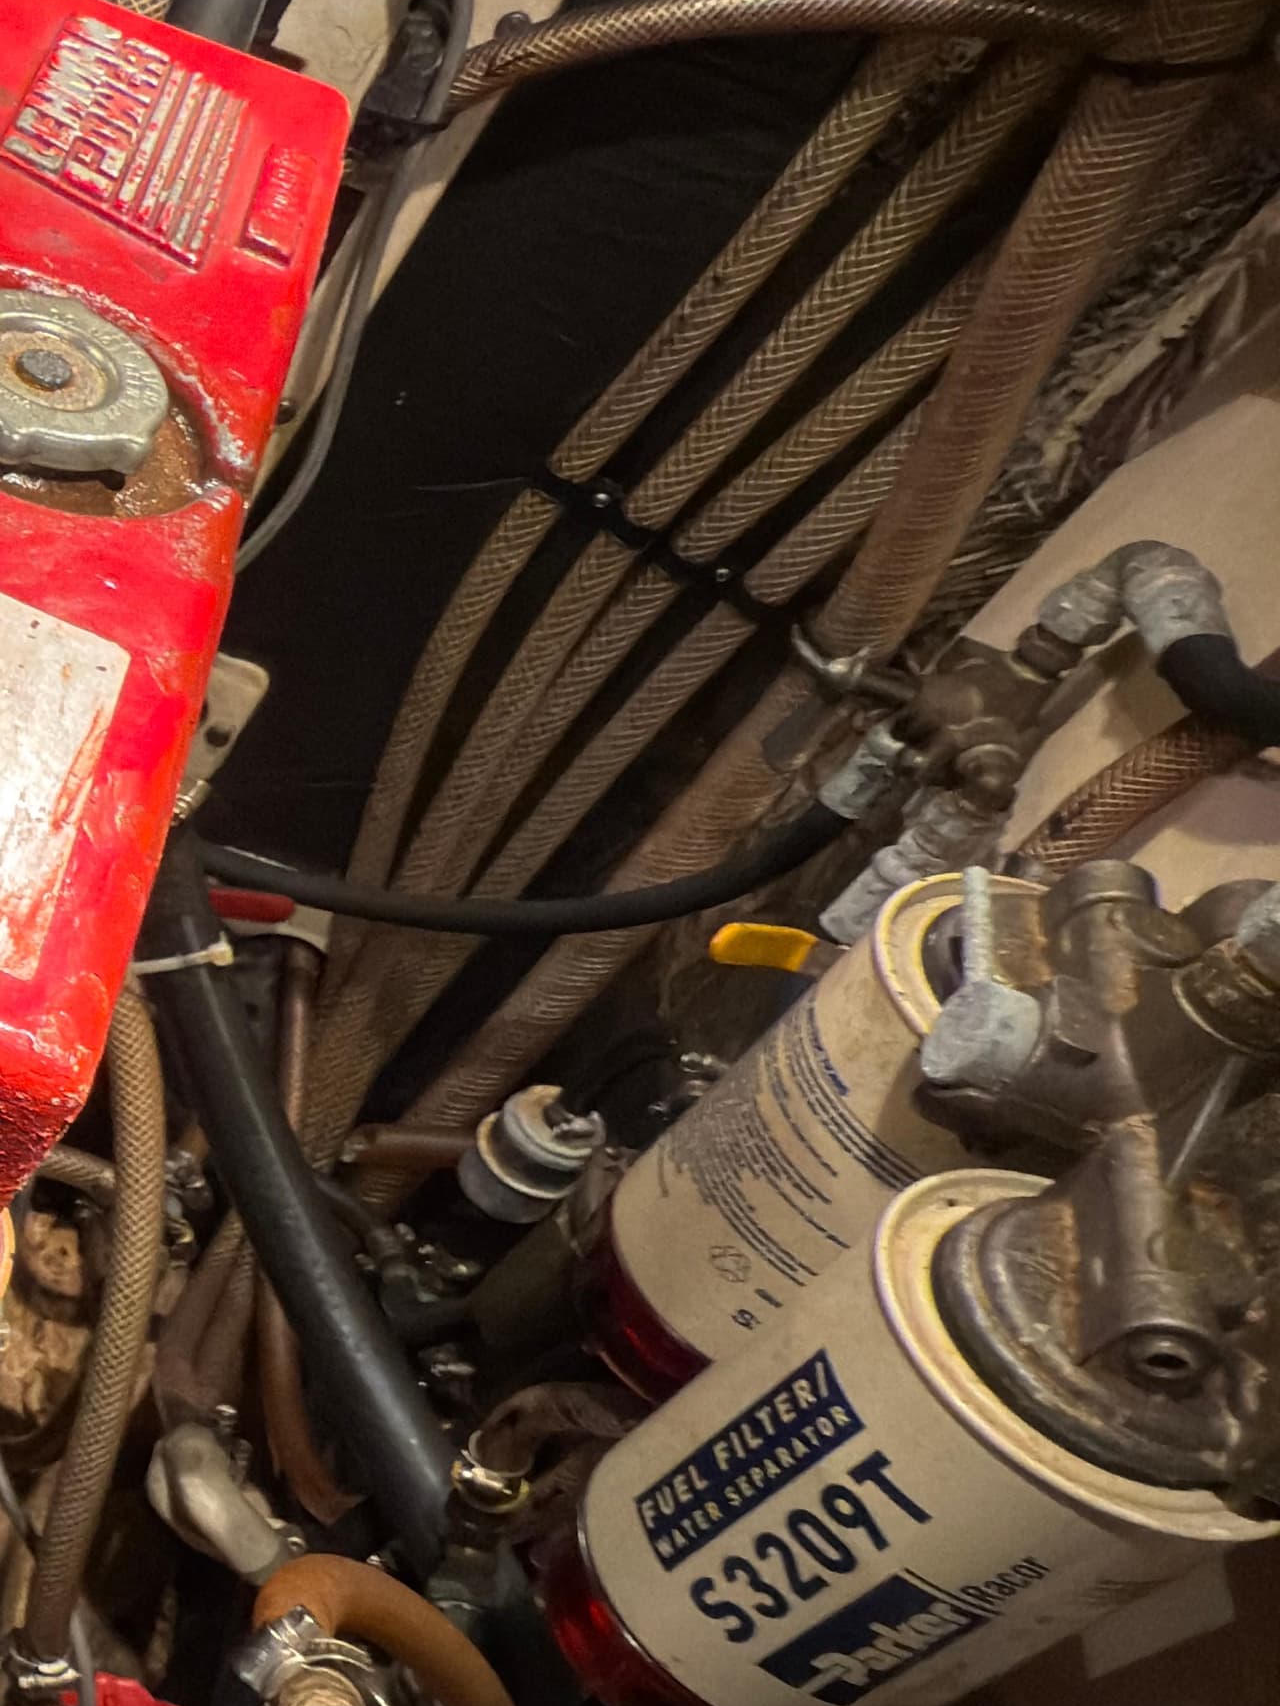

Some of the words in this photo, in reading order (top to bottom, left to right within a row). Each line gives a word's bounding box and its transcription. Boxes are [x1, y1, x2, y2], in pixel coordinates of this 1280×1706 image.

[0, 15, 124, 175] LEHMAN
[61, 37, 171, 199] POWER
[640, 1461, 709, 1530] FUEL
[712, 1359, 830, 1472] FILTER/
[653, 1499, 725, 1560] WATER
[723, 1404, 852, 1507] SEPARATOR
[689, 1449, 933, 1644] S3209T
[806, 1595, 972, 1689] Parker
[971, 1555, 1051, 1610] Racor
